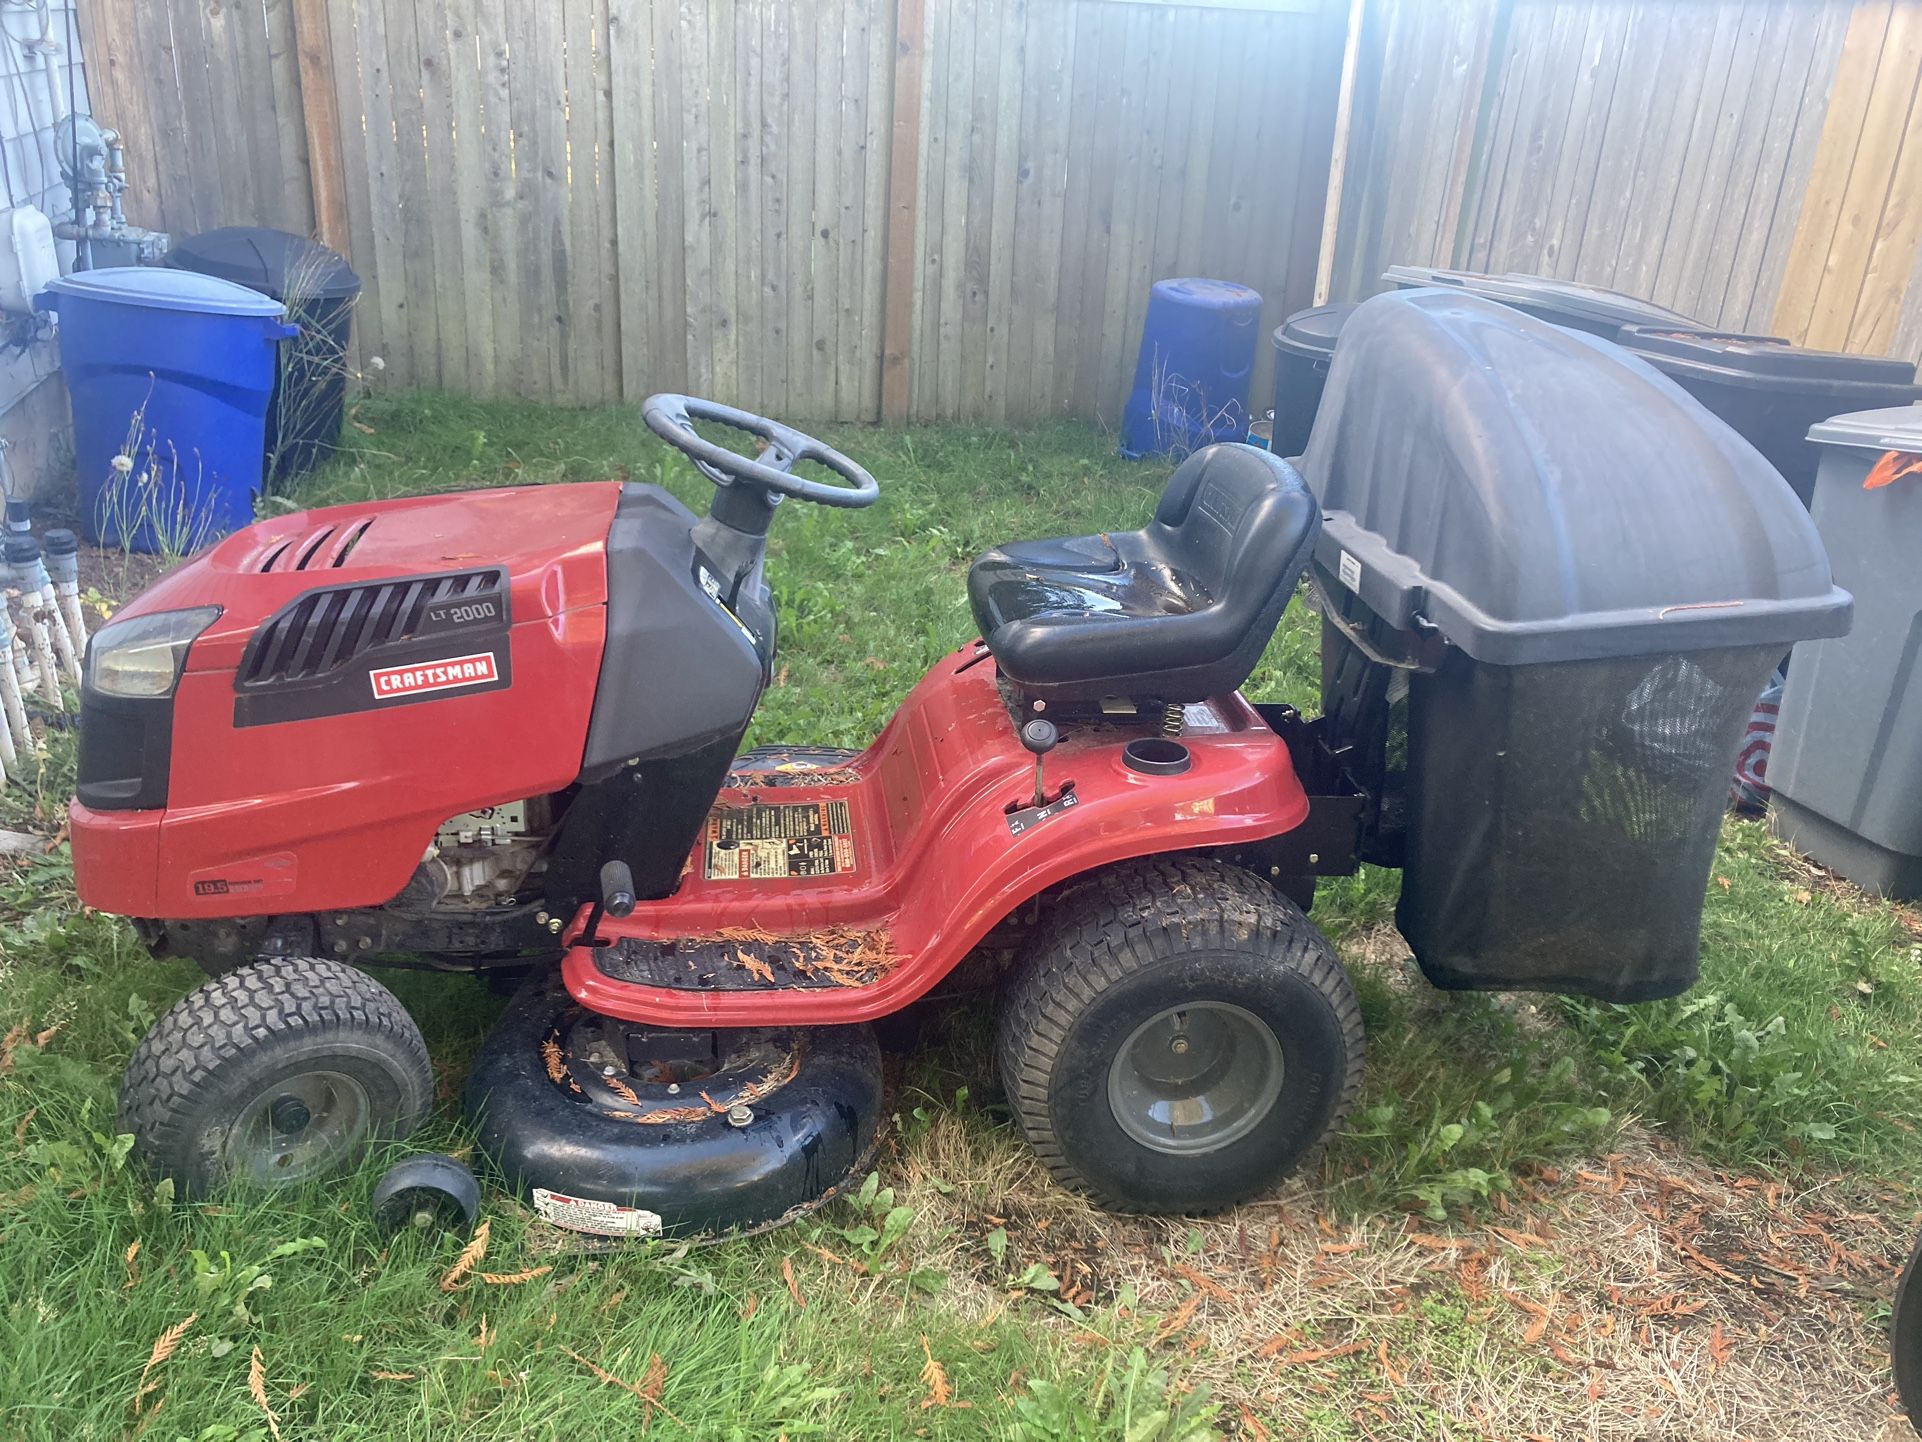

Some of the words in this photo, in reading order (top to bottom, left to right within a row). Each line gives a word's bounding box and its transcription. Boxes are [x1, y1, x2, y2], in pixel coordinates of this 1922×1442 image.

[430, 609, 446, 621] LT
[450, 602, 496, 623] 2000
[380, 661, 489, 691] CRAFTSMAN
[196, 881, 228, 894] 19.5
[577, 1199, 618, 1212] DANGER
